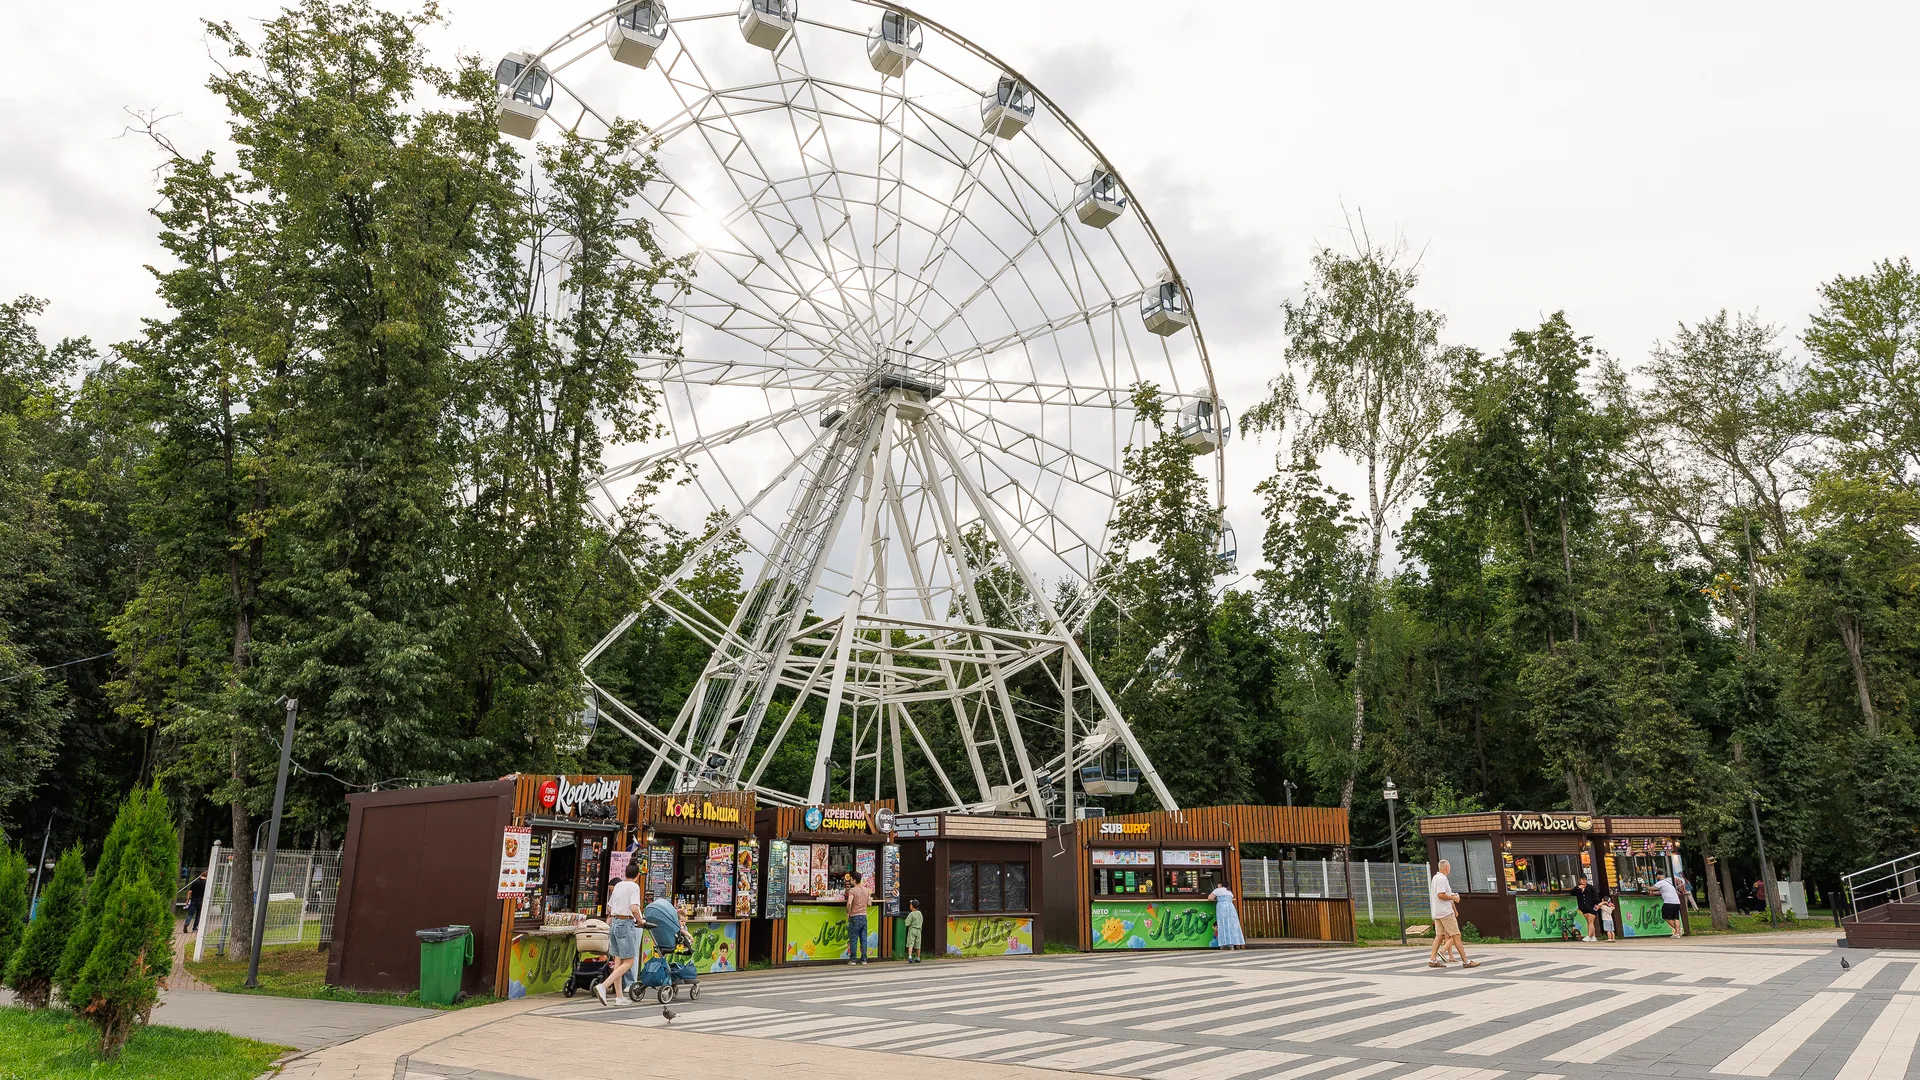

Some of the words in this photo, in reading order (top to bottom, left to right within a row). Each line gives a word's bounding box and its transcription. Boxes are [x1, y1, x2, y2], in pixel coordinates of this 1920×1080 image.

[555, 775, 620, 816] Кофейня
[822, 819, 867, 830] СЭНДВИЧИ
[824, 808, 865, 820] КРЕВЕТКИ
[1100, 822, 1150, 834] SUBWAY
[963, 917, 1016, 949] Лето
[1149, 907, 1214, 941] Лето
